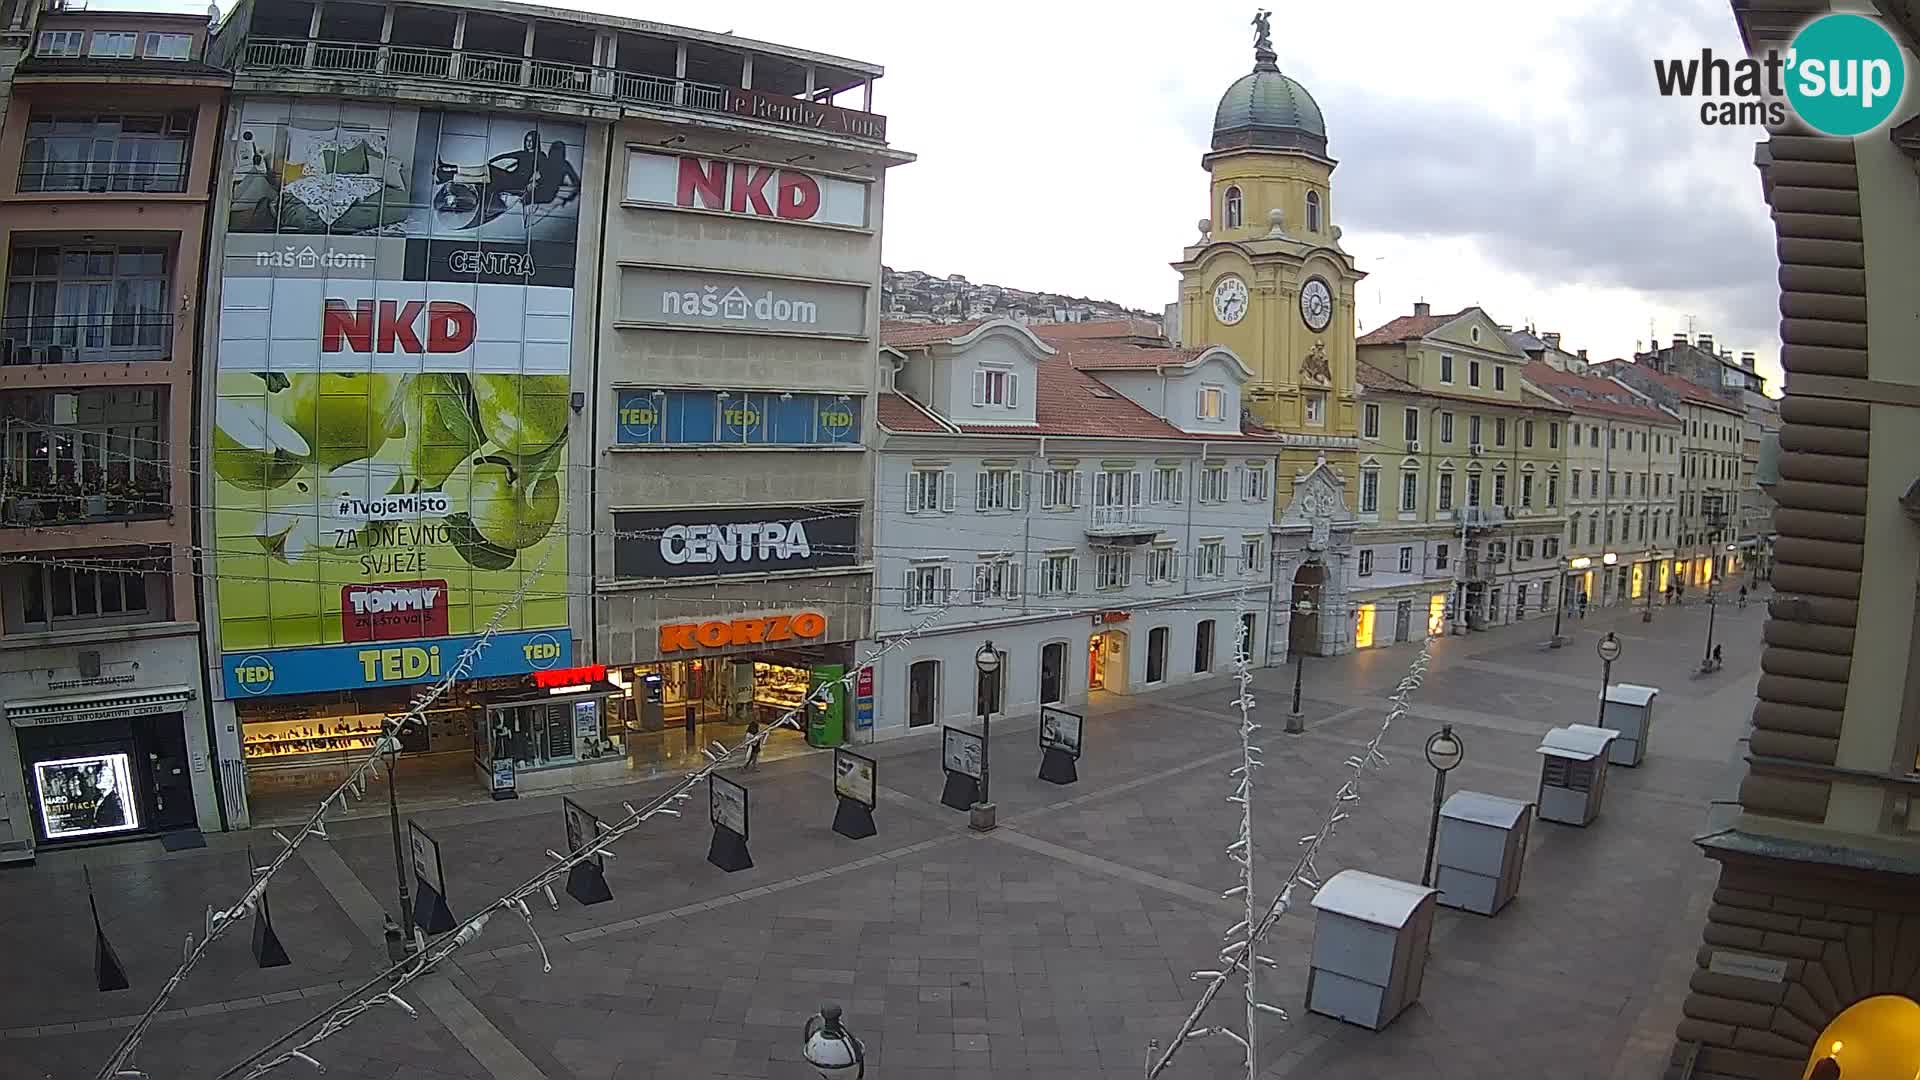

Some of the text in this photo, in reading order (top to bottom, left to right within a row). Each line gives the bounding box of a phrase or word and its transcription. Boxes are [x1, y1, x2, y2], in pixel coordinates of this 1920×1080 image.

[676, 158, 821, 220] NKD
[255, 245, 367, 268] naš dom
[450, 250, 536, 276] CENTRA
[662, 284, 817, 323] naš dom
[321, 298, 478, 354] NKD
[619, 408, 659, 425] TEDi
[724, 409, 761, 426] TEDi
[820, 411, 854, 427] TEDi
[339, 497, 447, 517] #TvojeMisto
[335, 524, 451, 549] ZA DNEVNO
[660, 520, 811, 565] CENTRA
[360, 547, 427, 575] SVJEŽE
[349, 587, 440, 615] TOMMY
[659, 612, 826, 654] KORZO
[359, 646, 442, 682] TEDi
[523, 643, 560, 660] TEDi
[234, 665, 275, 684] TEDi
